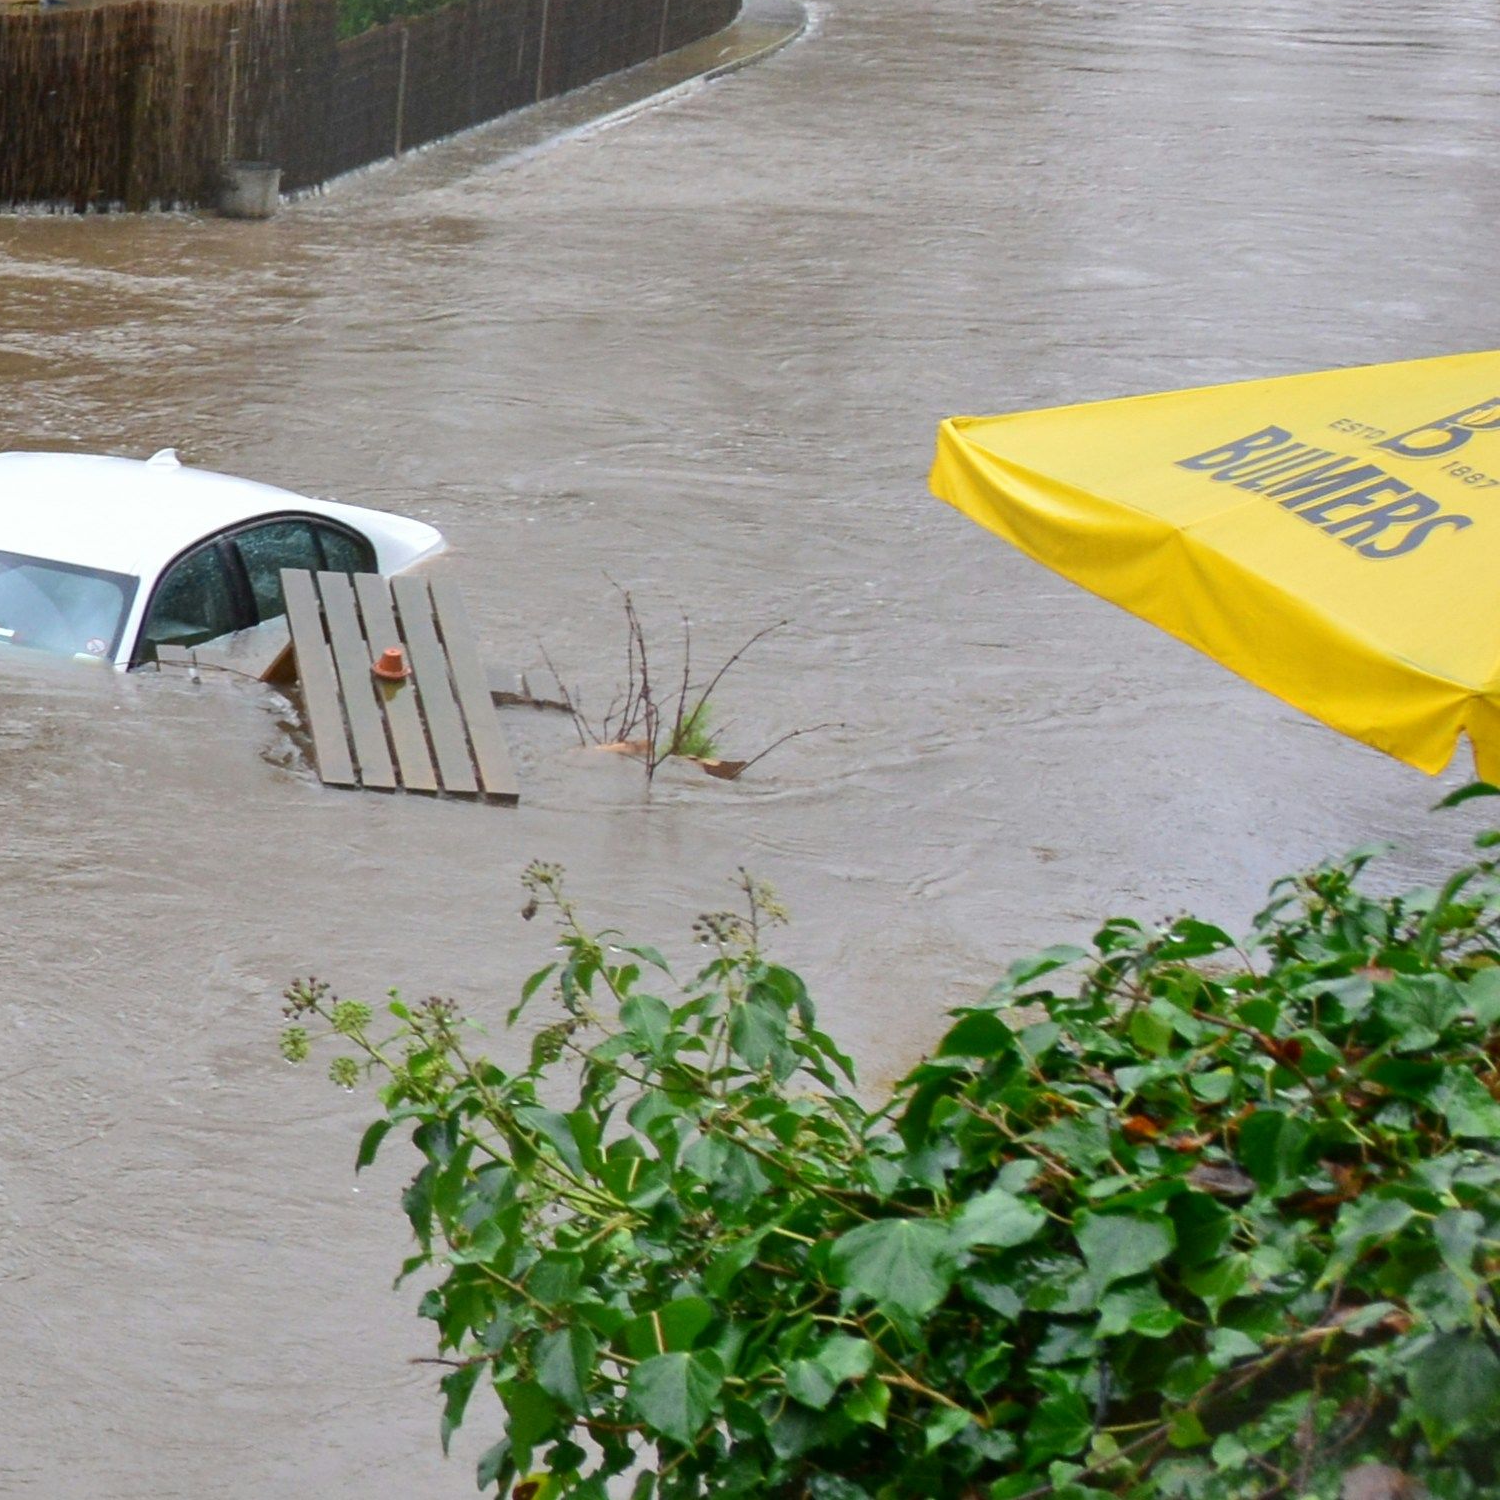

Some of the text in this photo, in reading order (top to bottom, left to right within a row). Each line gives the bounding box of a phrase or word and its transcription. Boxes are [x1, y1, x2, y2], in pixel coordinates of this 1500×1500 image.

[1329, 418, 1386, 440] ESTD
[1439, 461, 1500, 489] 1887
[1173, 424, 1474, 559] BULMERS
